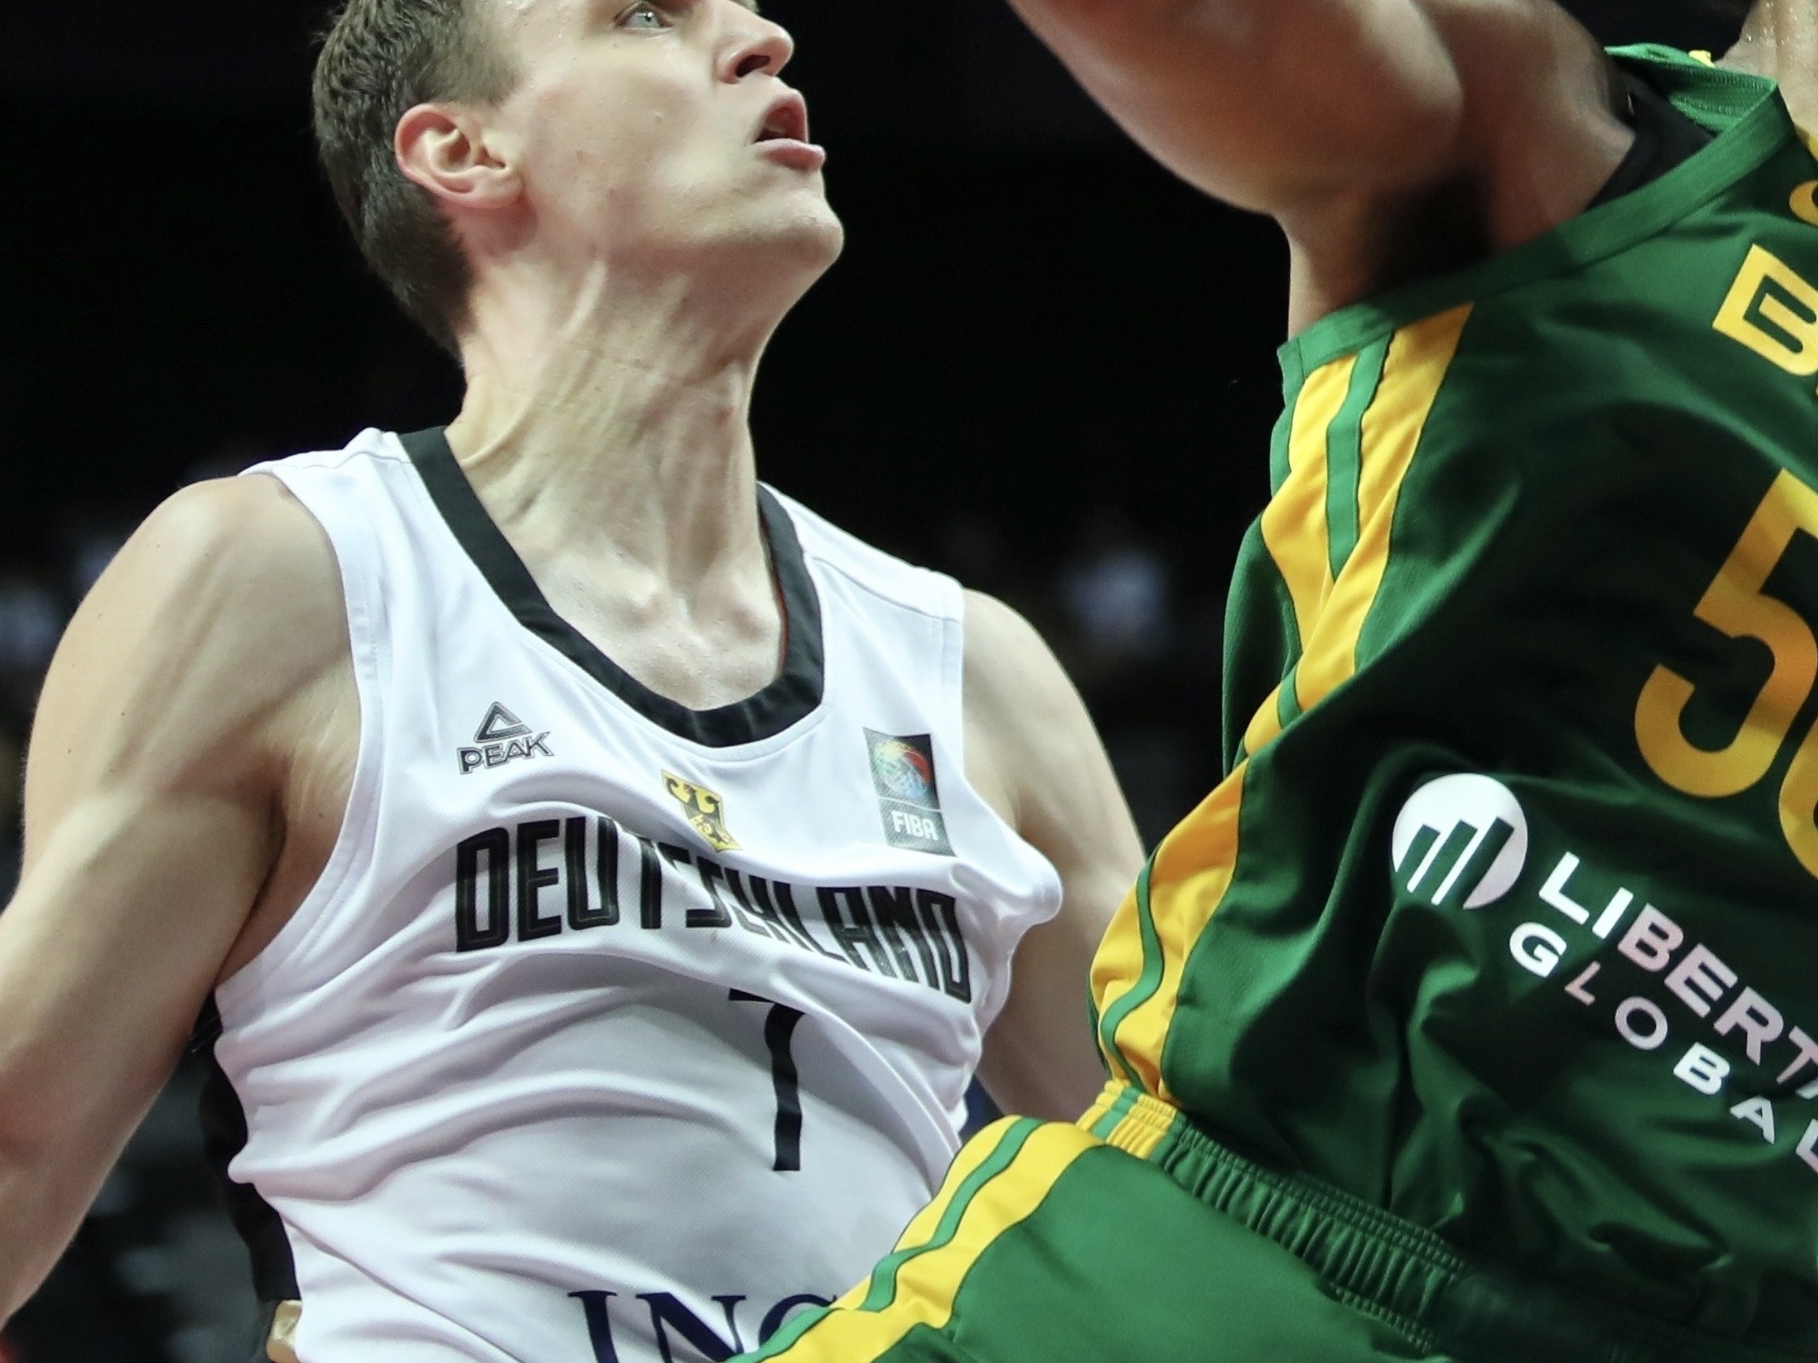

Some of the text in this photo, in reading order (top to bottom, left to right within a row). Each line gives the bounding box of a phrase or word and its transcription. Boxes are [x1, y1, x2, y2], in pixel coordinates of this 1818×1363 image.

[457, 731, 555, 775] PEAK
[891, 809, 940, 841] FIBA
[728, 988, 807, 1173] 7
